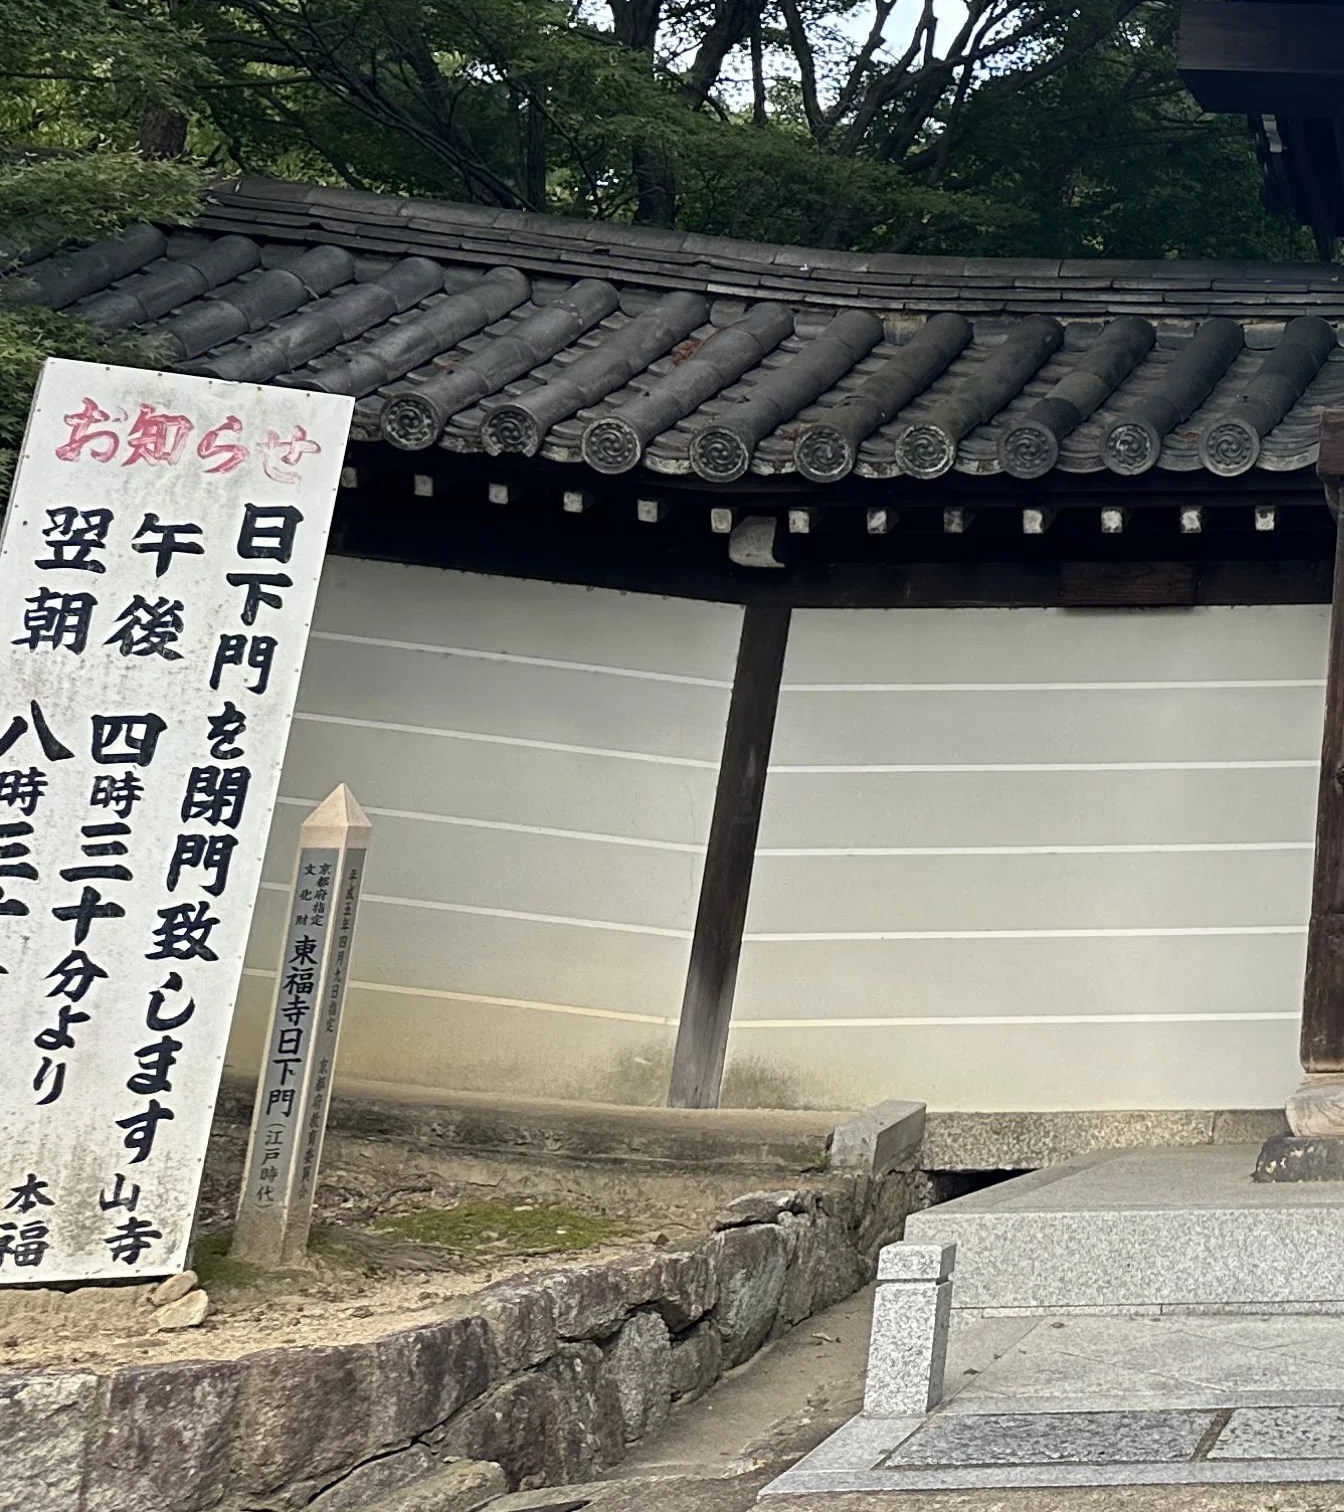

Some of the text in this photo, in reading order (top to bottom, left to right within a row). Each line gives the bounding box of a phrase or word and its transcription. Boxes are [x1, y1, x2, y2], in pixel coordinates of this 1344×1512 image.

[55, 397, 321, 484] お知らせ
[116, 503, 304, 1164] 日下門を閉門致します
[295, 864, 316, 926] 文化財
[310, 862, 332, 927] 京都府指定
[266, 935, 318, 1118] 東福寺日下門
